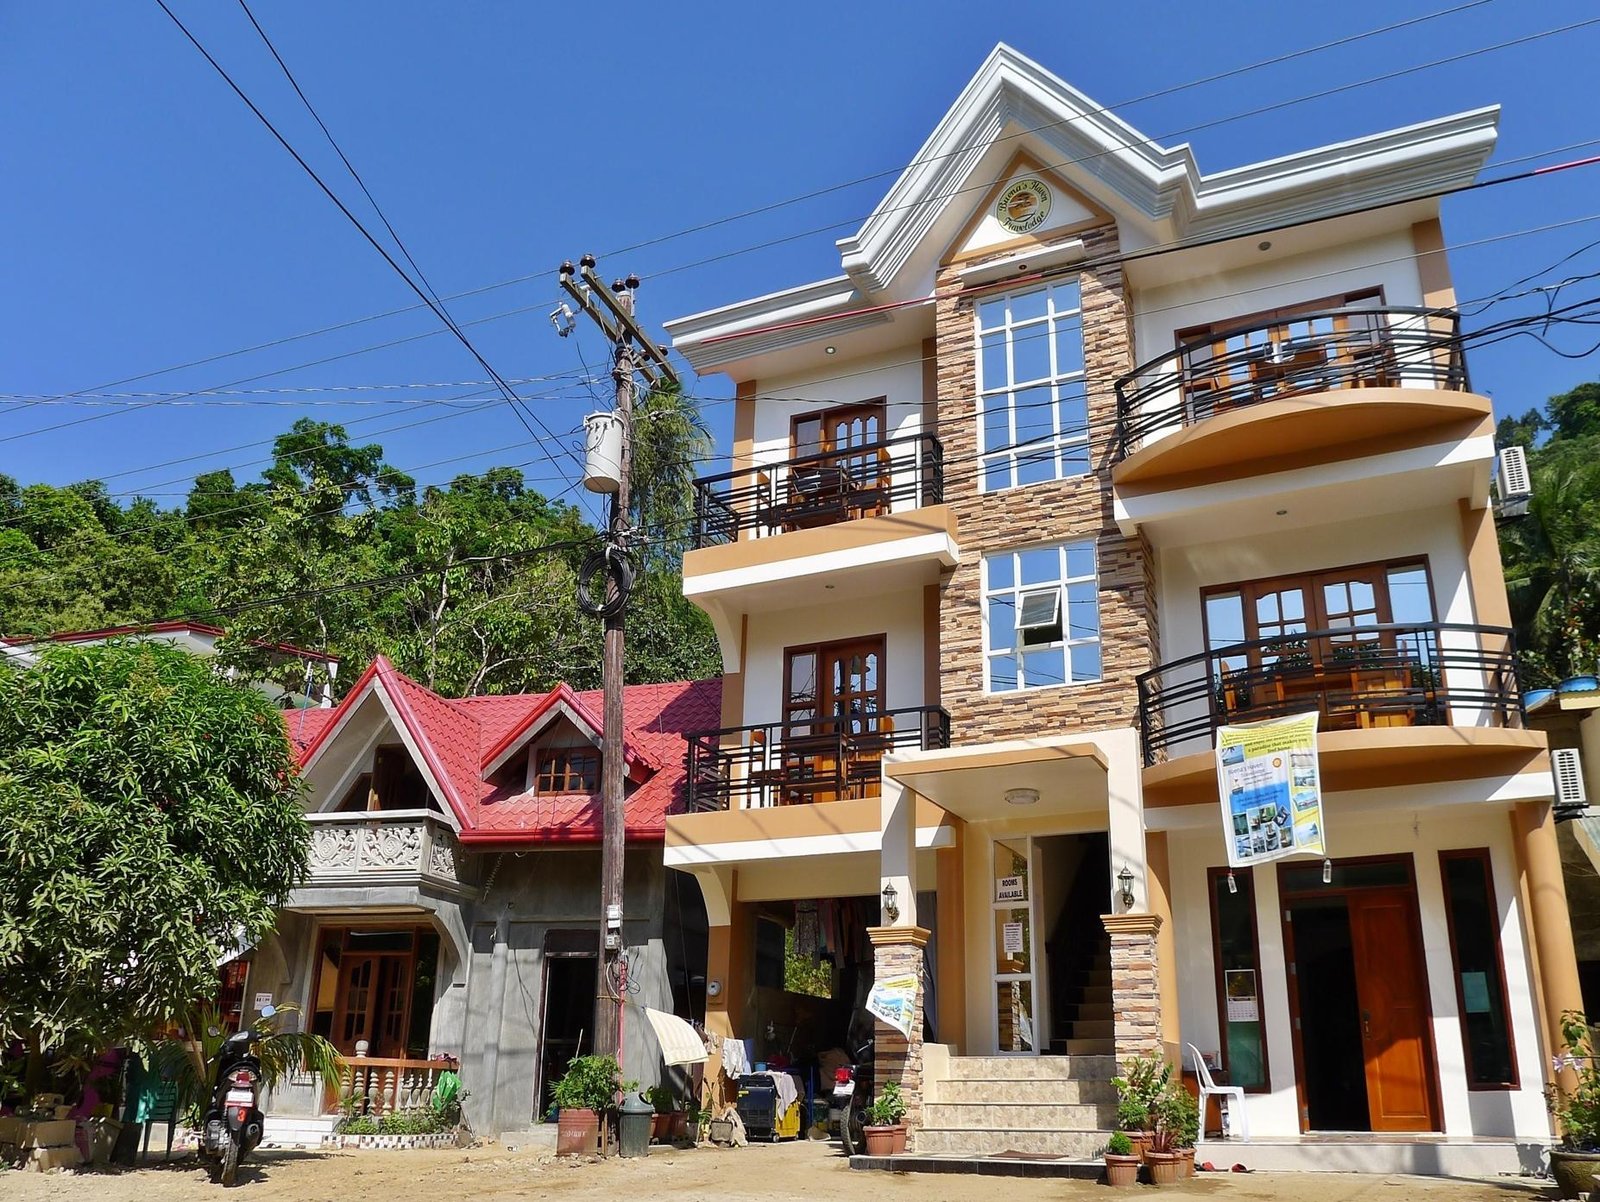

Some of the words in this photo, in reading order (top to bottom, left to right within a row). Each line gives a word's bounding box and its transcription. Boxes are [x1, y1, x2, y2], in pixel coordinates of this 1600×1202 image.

[999, 182, 1028, 212] Buena's
[1030, 181, 1047, 203] Haven
[1003, 211, 1045, 232] Travelodge
[1251, 744, 1271, 752] paradise
[1002, 879, 1018, 887] ROOMS
[999, 890, 1022, 899] AVAILABLE
